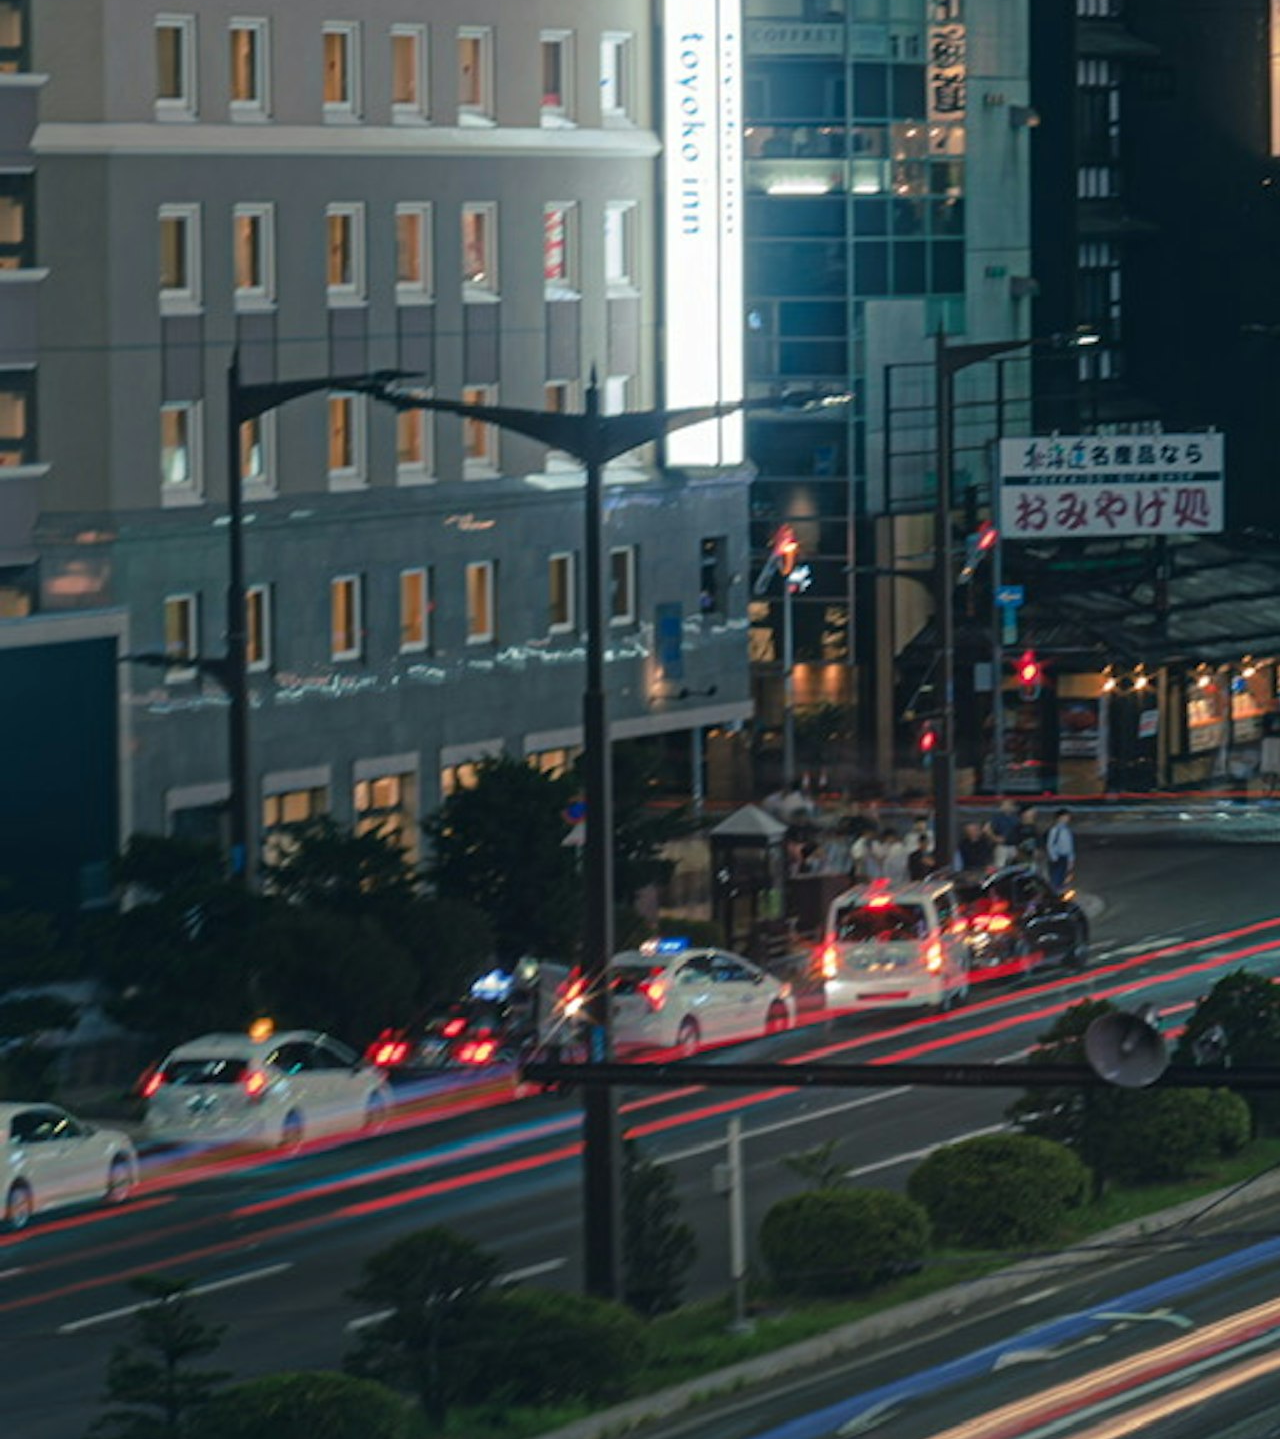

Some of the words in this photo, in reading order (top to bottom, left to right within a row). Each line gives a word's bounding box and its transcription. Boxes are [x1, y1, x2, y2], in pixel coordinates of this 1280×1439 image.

[678, 33, 706, 163] toyoko
[682, 177, 700, 237] inn
[1015, 487, 1210, 531] おみやげ処
